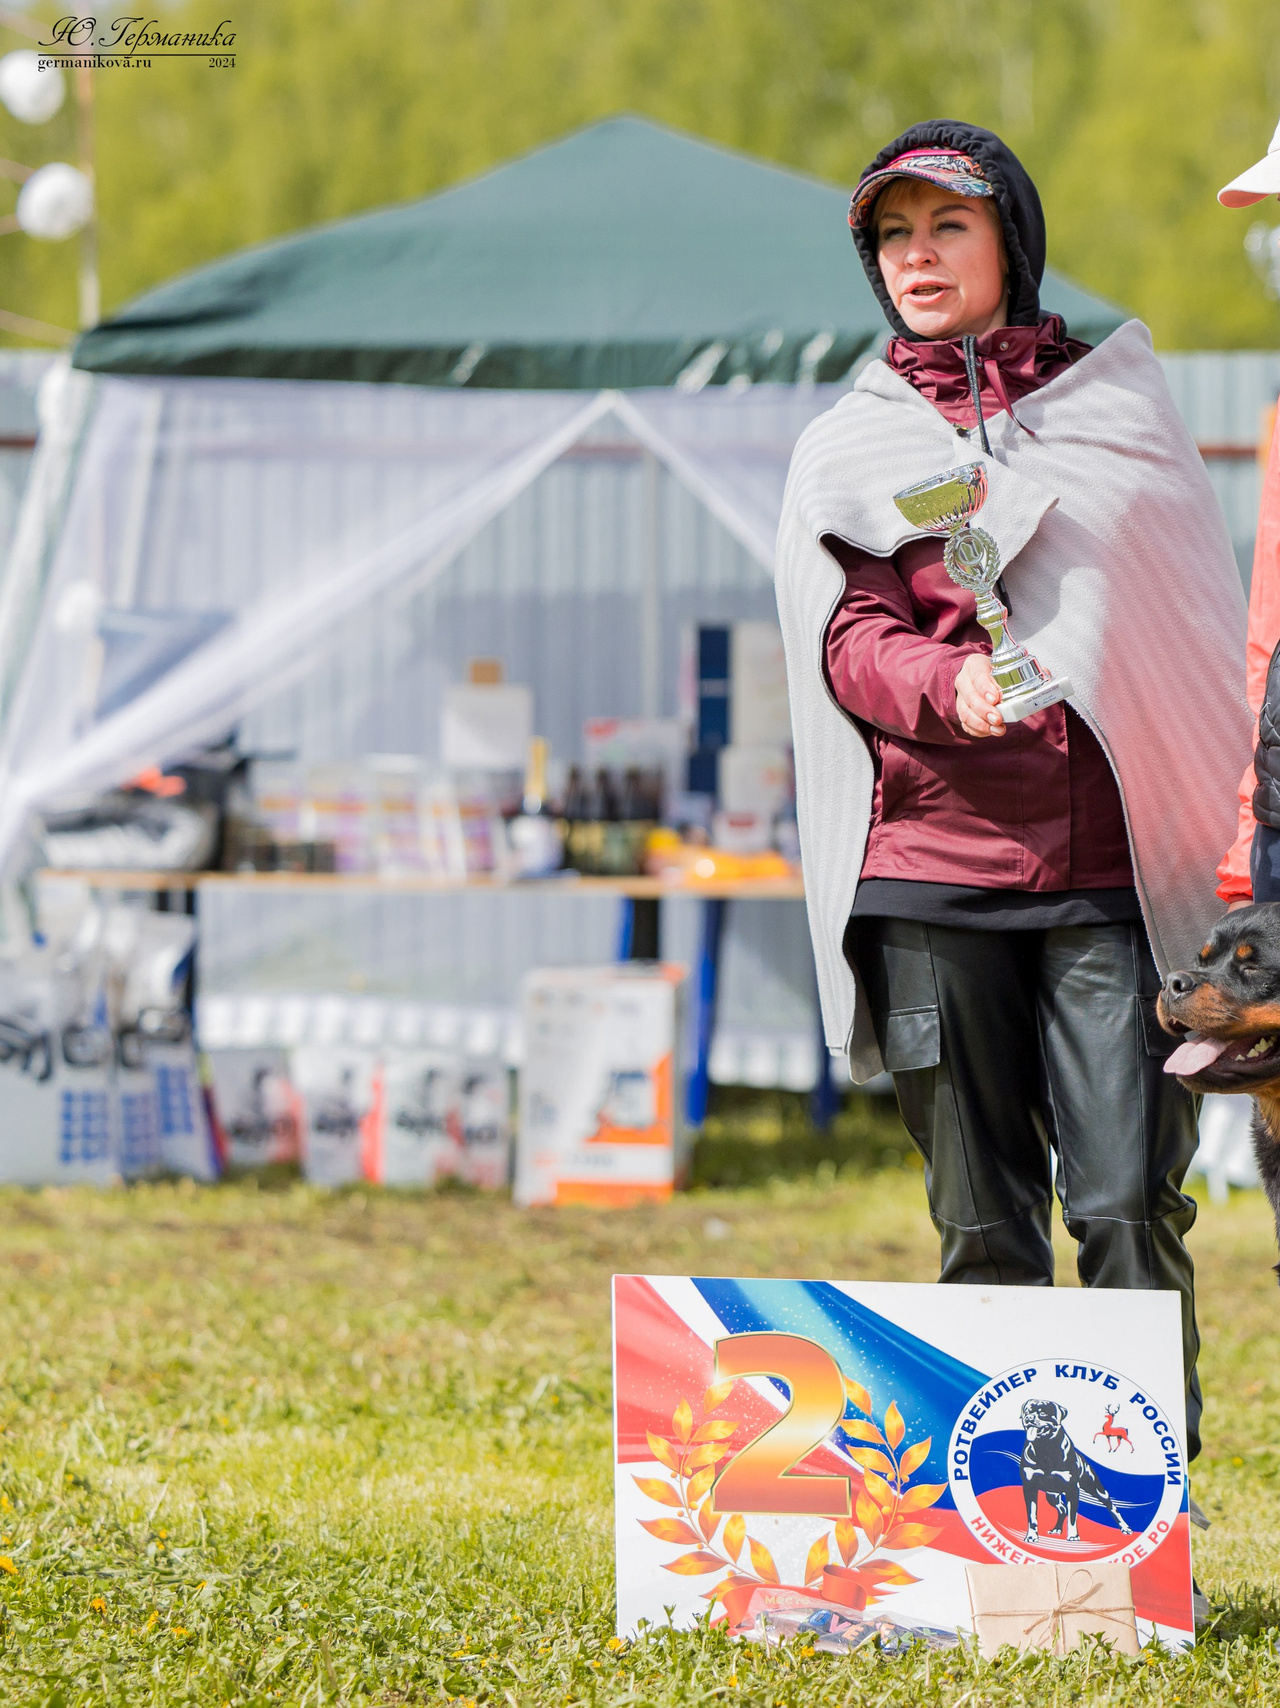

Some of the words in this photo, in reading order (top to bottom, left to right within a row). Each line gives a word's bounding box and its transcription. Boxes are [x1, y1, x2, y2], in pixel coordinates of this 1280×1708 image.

[711, 1331, 852, 1517] 2
[954, 1367, 1038, 1481] РОТВЕЙЛЕР
[1055, 1364, 1120, 1391] КЛУБ
[1129, 1392, 1182, 1486] РОССИИ
[1152, 1519, 1170, 1545] РО
